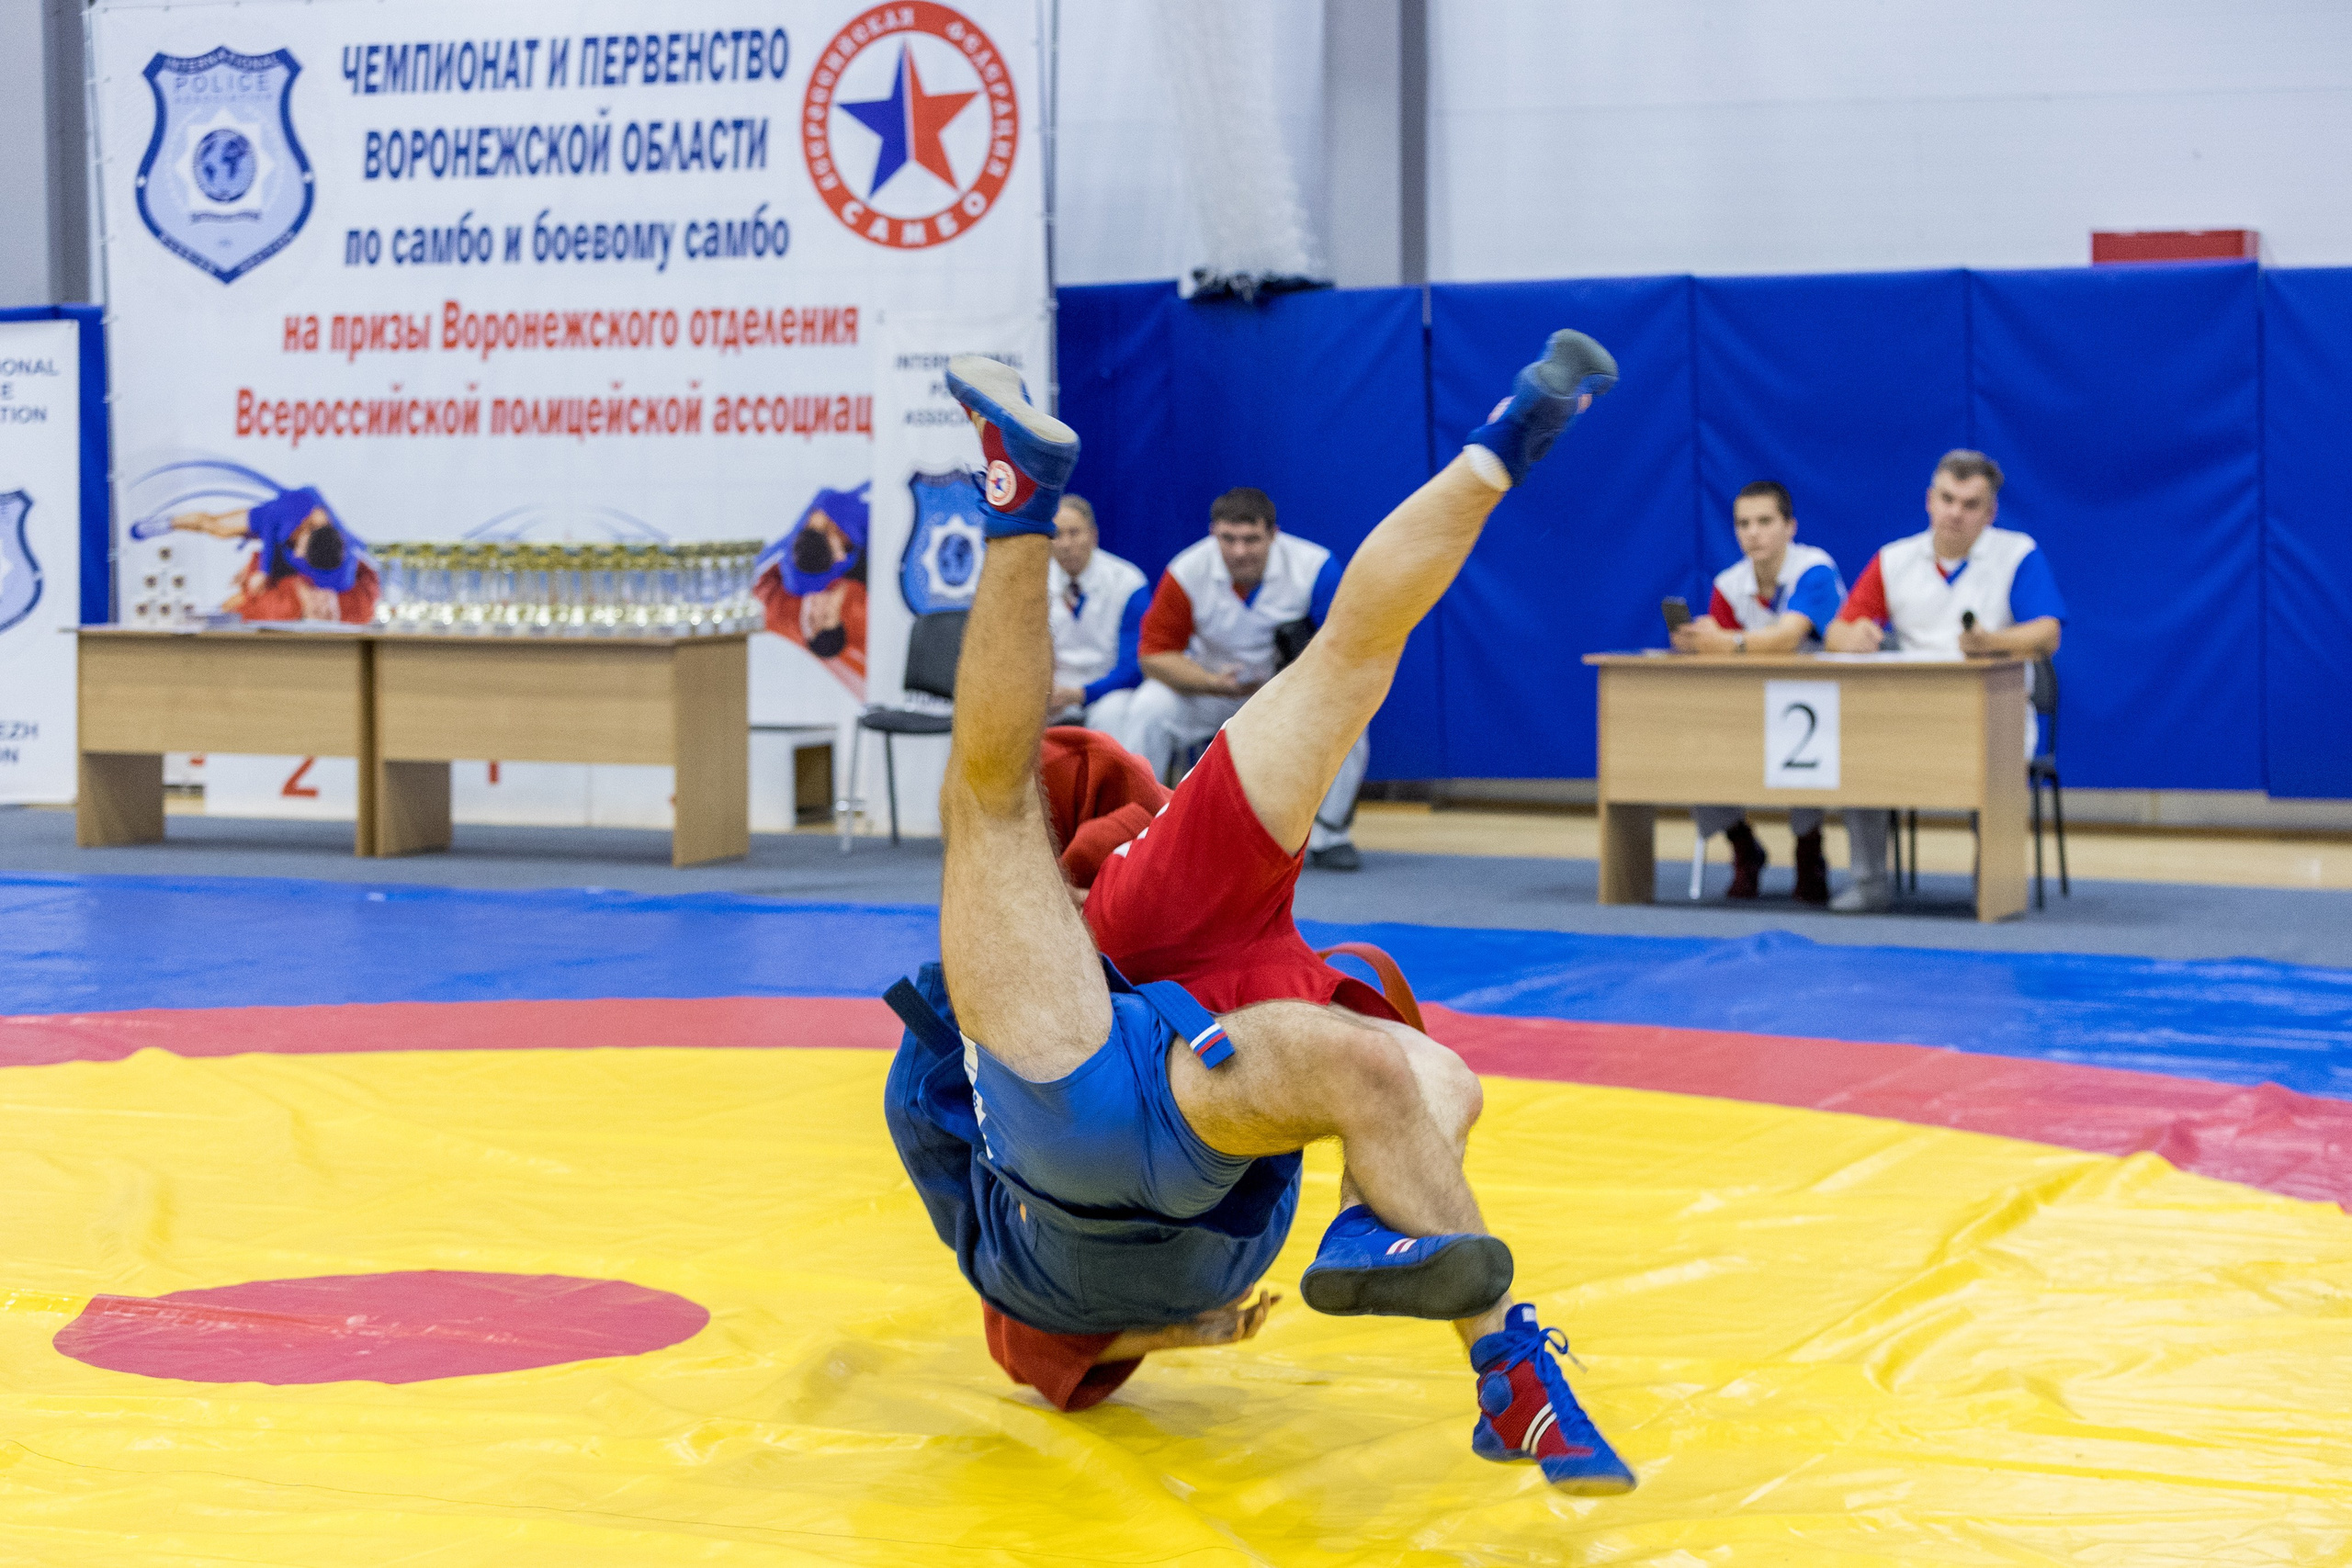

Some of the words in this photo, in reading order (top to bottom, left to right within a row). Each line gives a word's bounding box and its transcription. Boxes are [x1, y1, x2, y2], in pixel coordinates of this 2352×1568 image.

[173, 73, 270, 94] POLICE
[342, 38, 540, 94] ЧЕМПИОНАТ
[548, 38, 571, 87] И
[579, 28, 790, 87] ПЕРВЕНСТВО
[364, 107, 613, 181] ВОРОНЕЖСКОЙ
[621, 118, 770, 174] ОБЛАСТИ
[345, 228, 382, 265] по
[391, 210, 494, 265] самбо
[503, 226, 523, 263] и
[532, 209, 674, 273] боевому
[684, 203, 790, 260] самбо
[841, 189, 987, 246] САМБО
[283, 314, 320, 353] на
[331, 312, 431, 362] призы
[441, 300, 678, 360] Воронежского
[689, 306, 860, 352] отделения
[236, 383, 480, 446] Всероссийской
[491, 381, 703, 443] полицейской
[1781, 701, 1820, 769] 2
